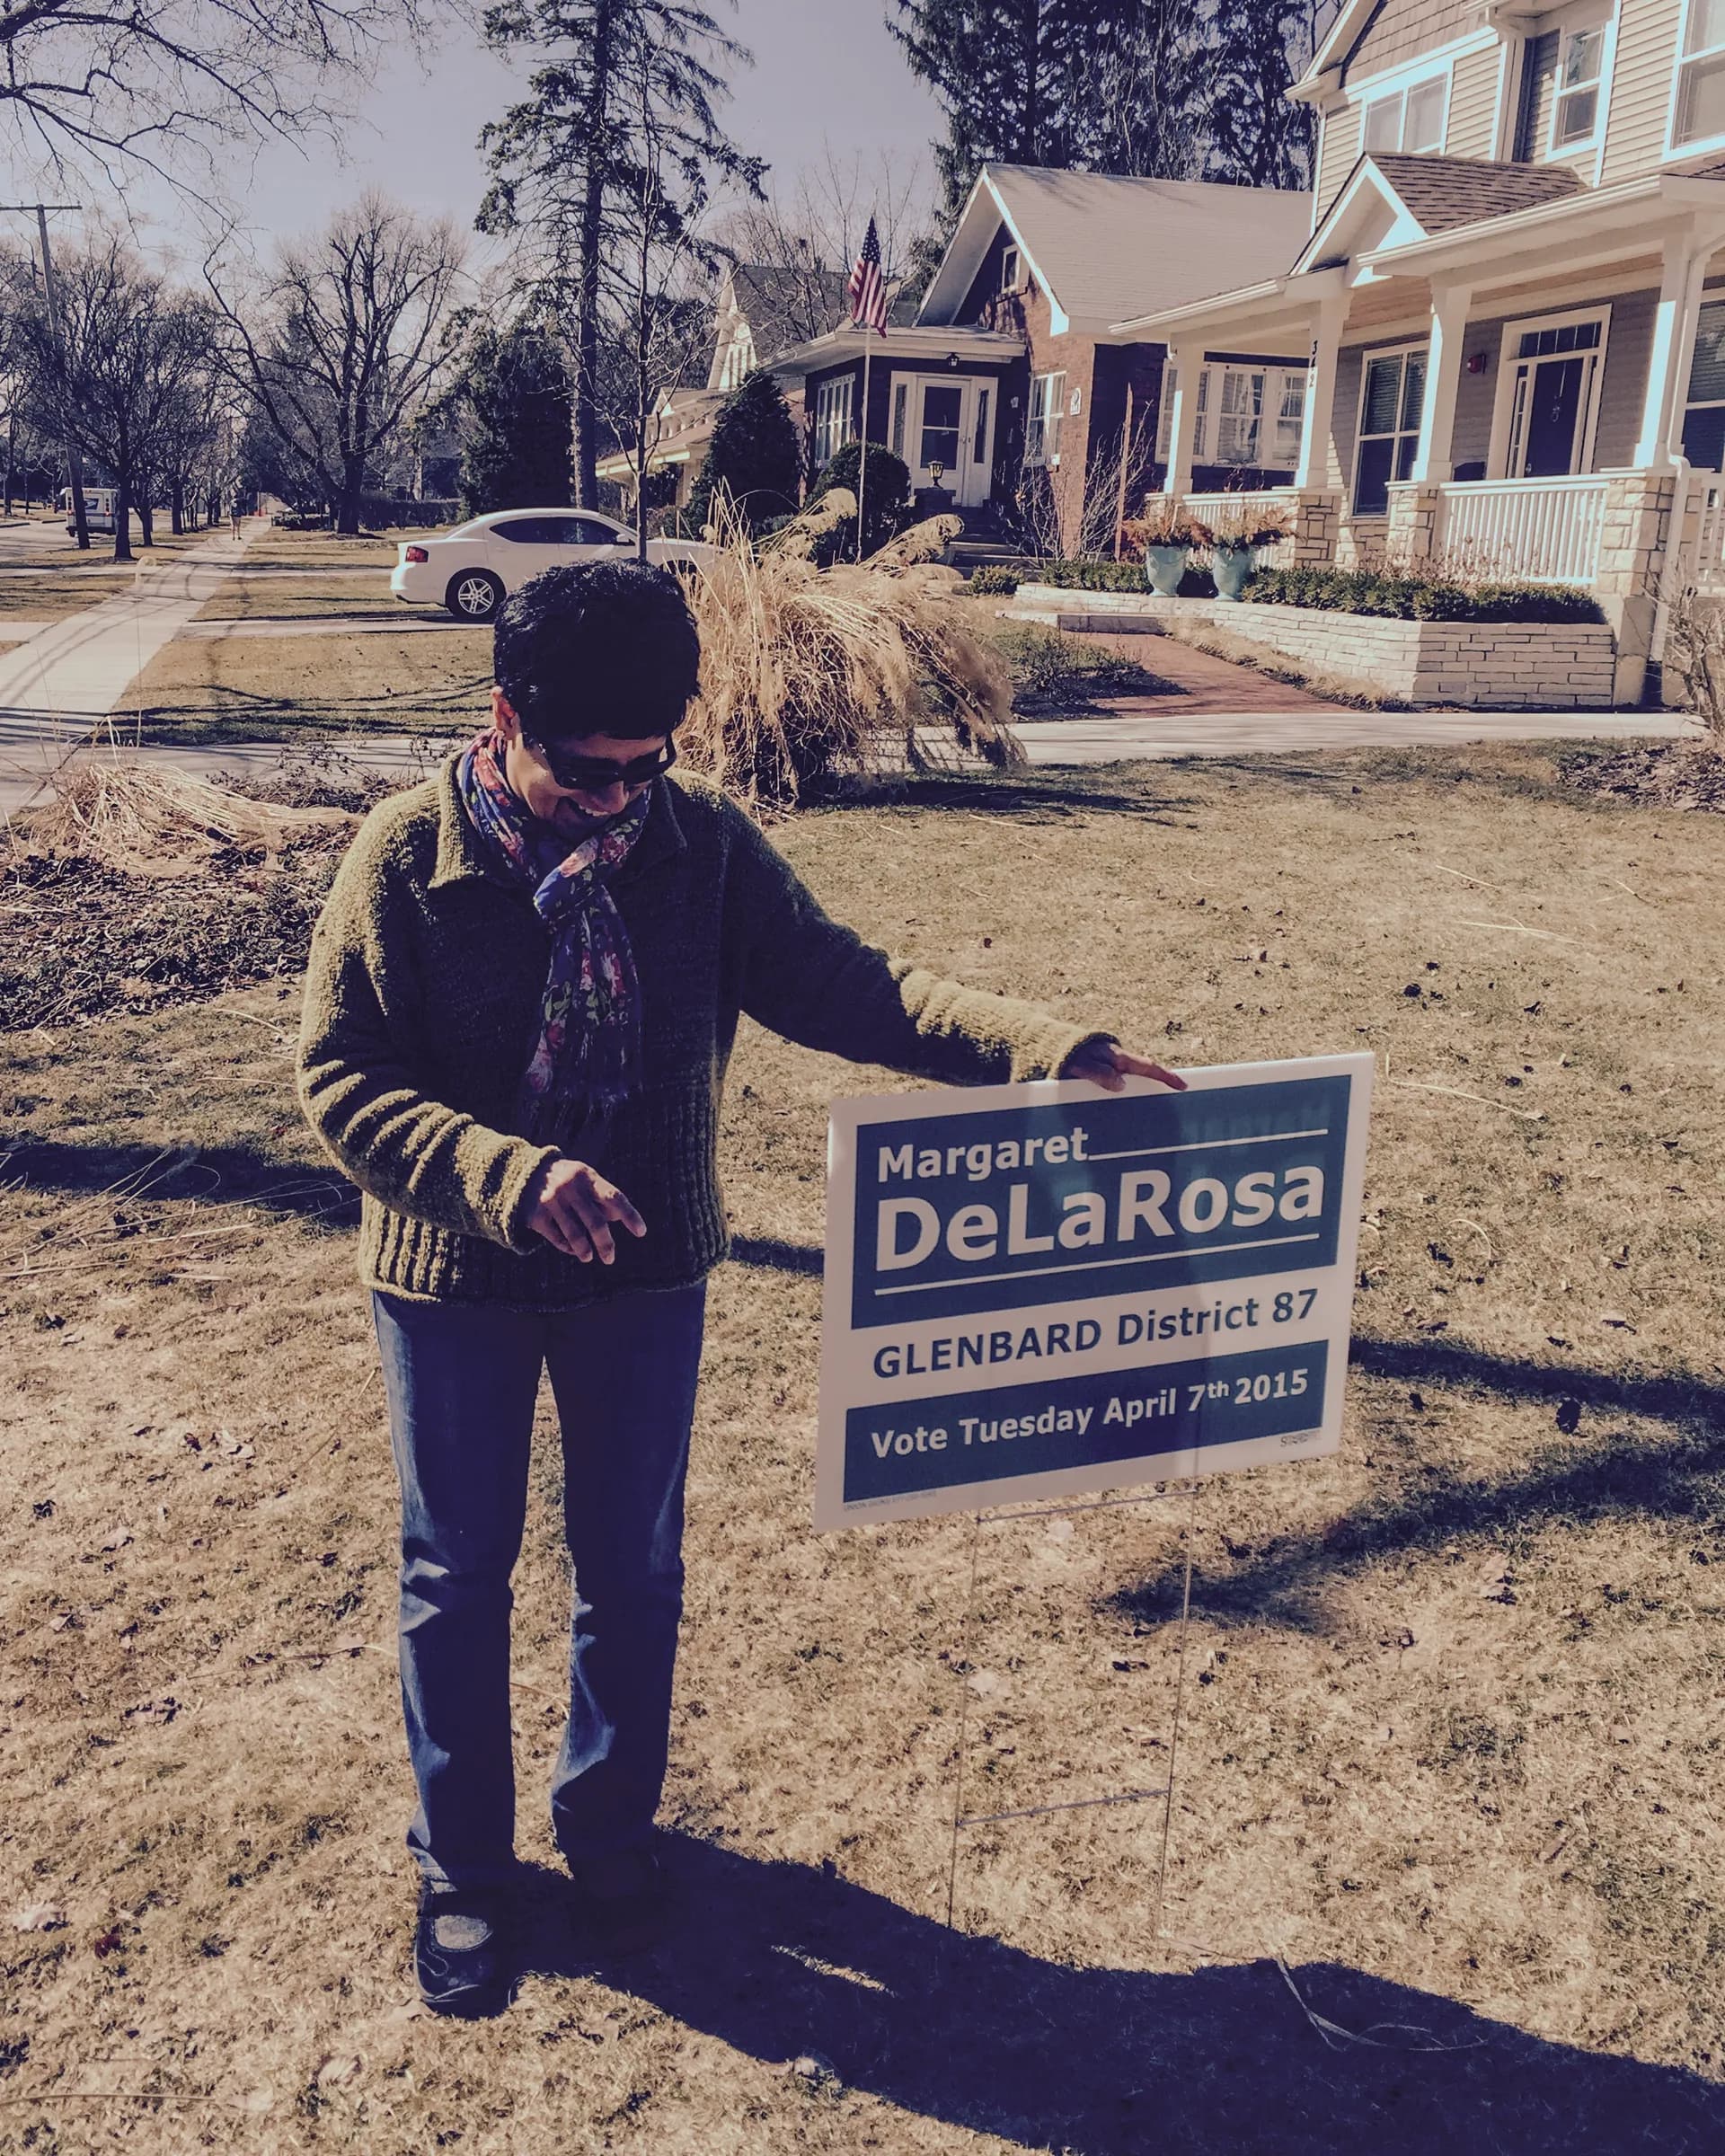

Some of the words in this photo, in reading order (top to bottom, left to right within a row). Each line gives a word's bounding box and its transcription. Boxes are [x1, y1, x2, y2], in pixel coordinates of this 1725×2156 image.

[877, 1126, 1090, 1183] Margaret
[874, 1164, 1325, 1273] DeLaRosa
[872, 1318, 1103, 1380] GLENBARD
[1116, 1296, 1260, 1347] District
[1271, 1287, 1319, 1324] 87
[871, 1426, 948, 1459] Vote
[958, 1405, 1094, 1446] Tuesday
[1101, 1387, 1177, 1428] April
[1187, 1379, 1230, 1412] 7th
[1233, 1368, 1309, 1405] 2015
